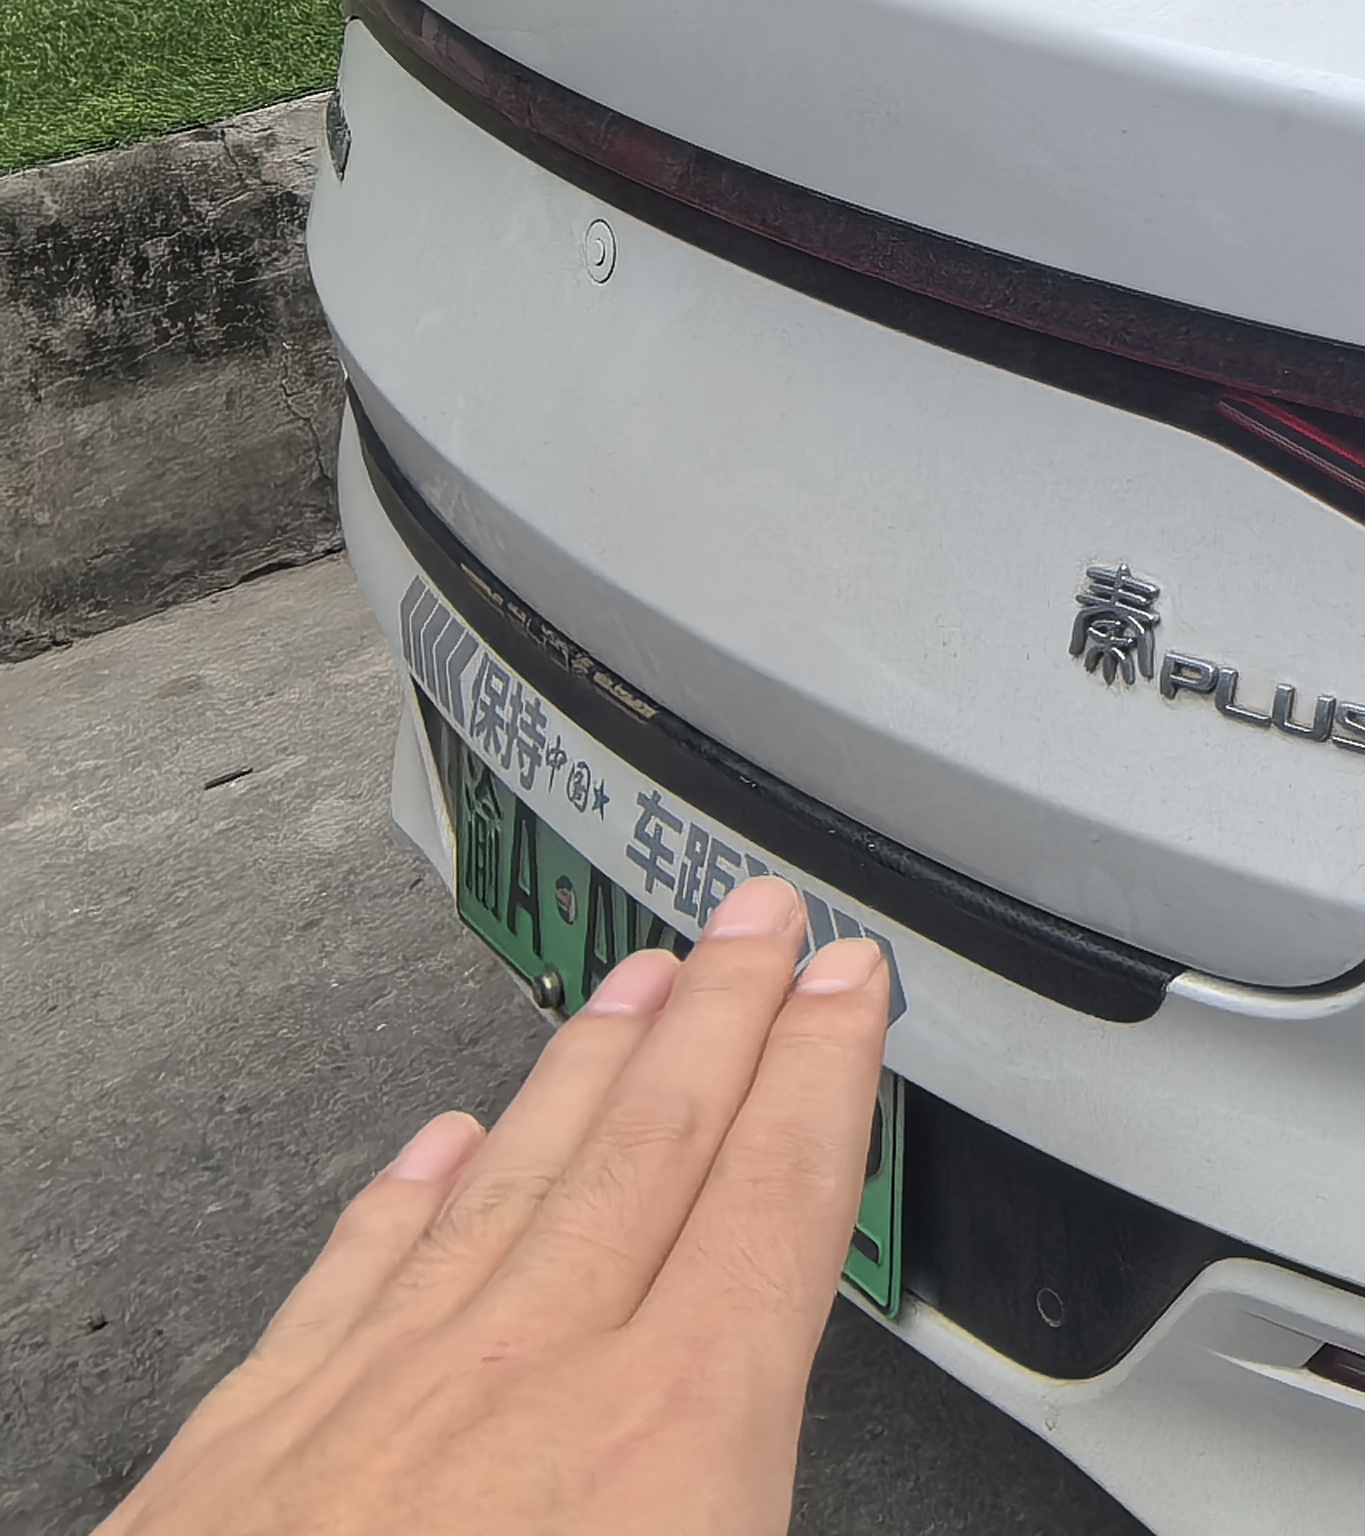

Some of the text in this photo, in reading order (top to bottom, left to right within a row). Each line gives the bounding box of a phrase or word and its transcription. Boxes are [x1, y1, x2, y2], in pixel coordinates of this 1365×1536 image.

[1069, 564, 1161, 686] 秦
[469, 652, 547, 791] 保持
[626, 790, 743, 930] 车距
